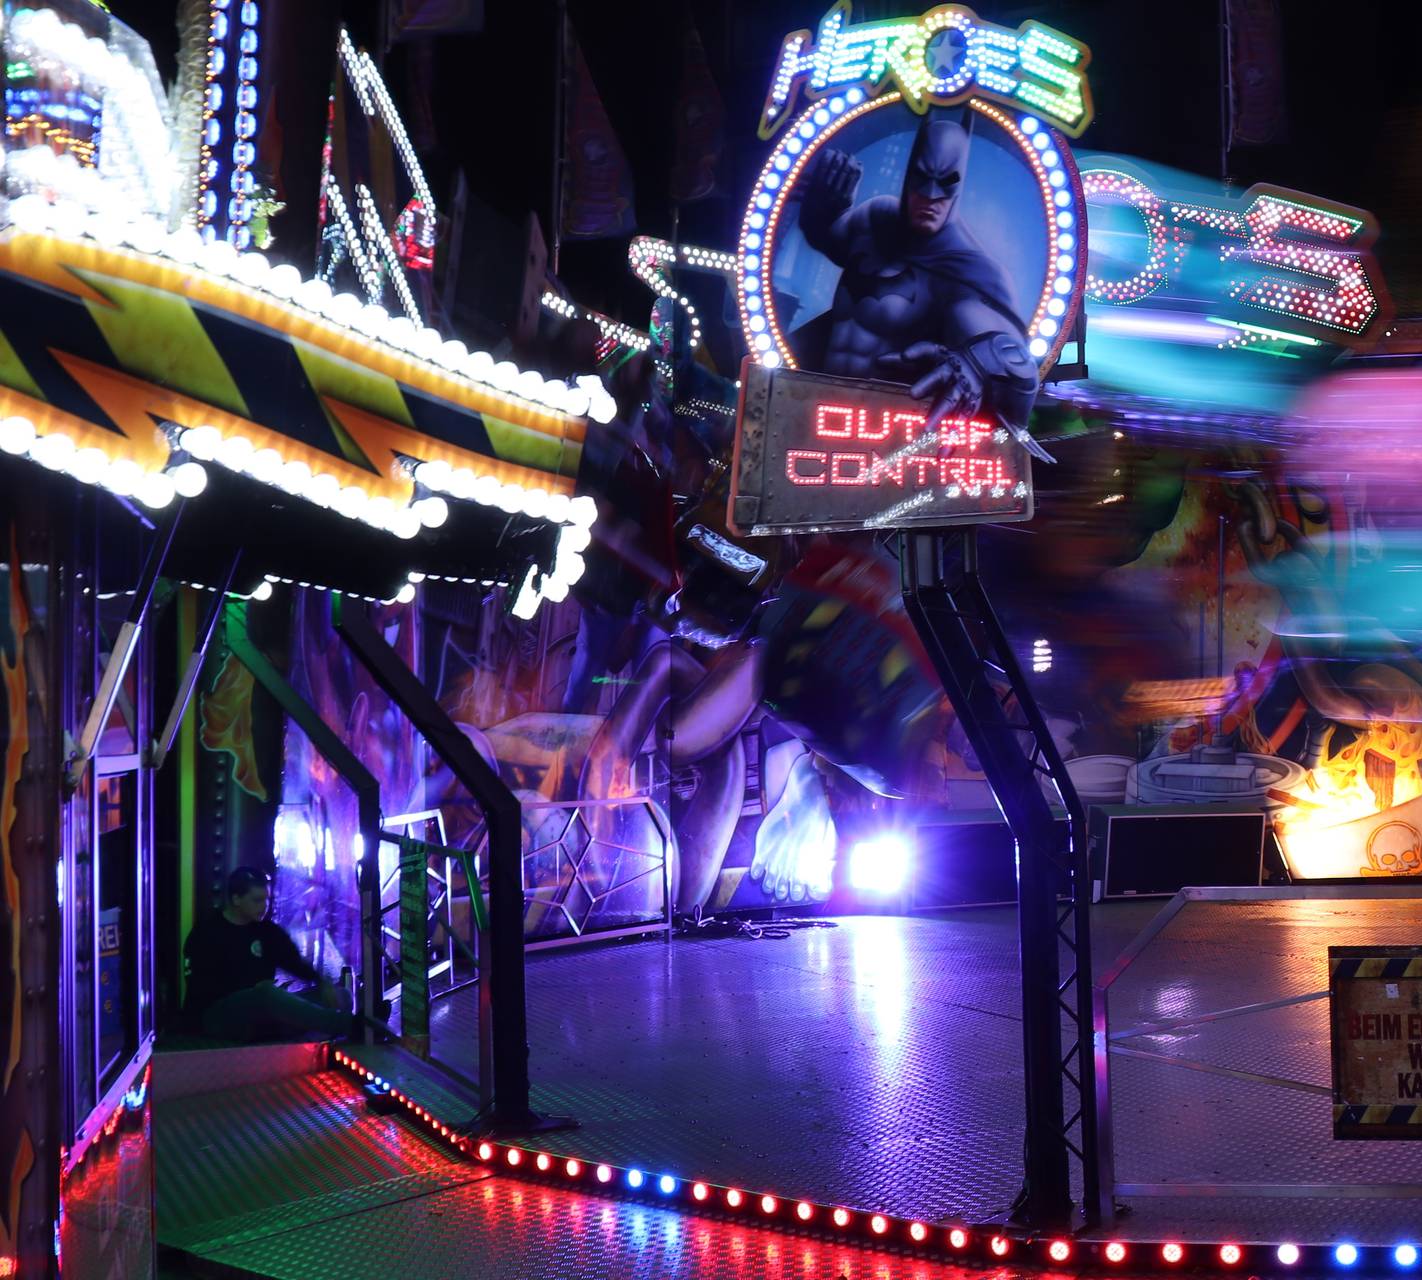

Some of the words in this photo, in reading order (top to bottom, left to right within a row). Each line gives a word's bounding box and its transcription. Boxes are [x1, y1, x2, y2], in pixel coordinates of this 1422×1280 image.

[766, 8, 1086, 121] HEROES
[815, 402, 927, 443] OUT
[940, 418, 992, 452] OF
[785, 448, 1013, 490] CONTROL
[1348, 1013, 1402, 1041] BEIM
